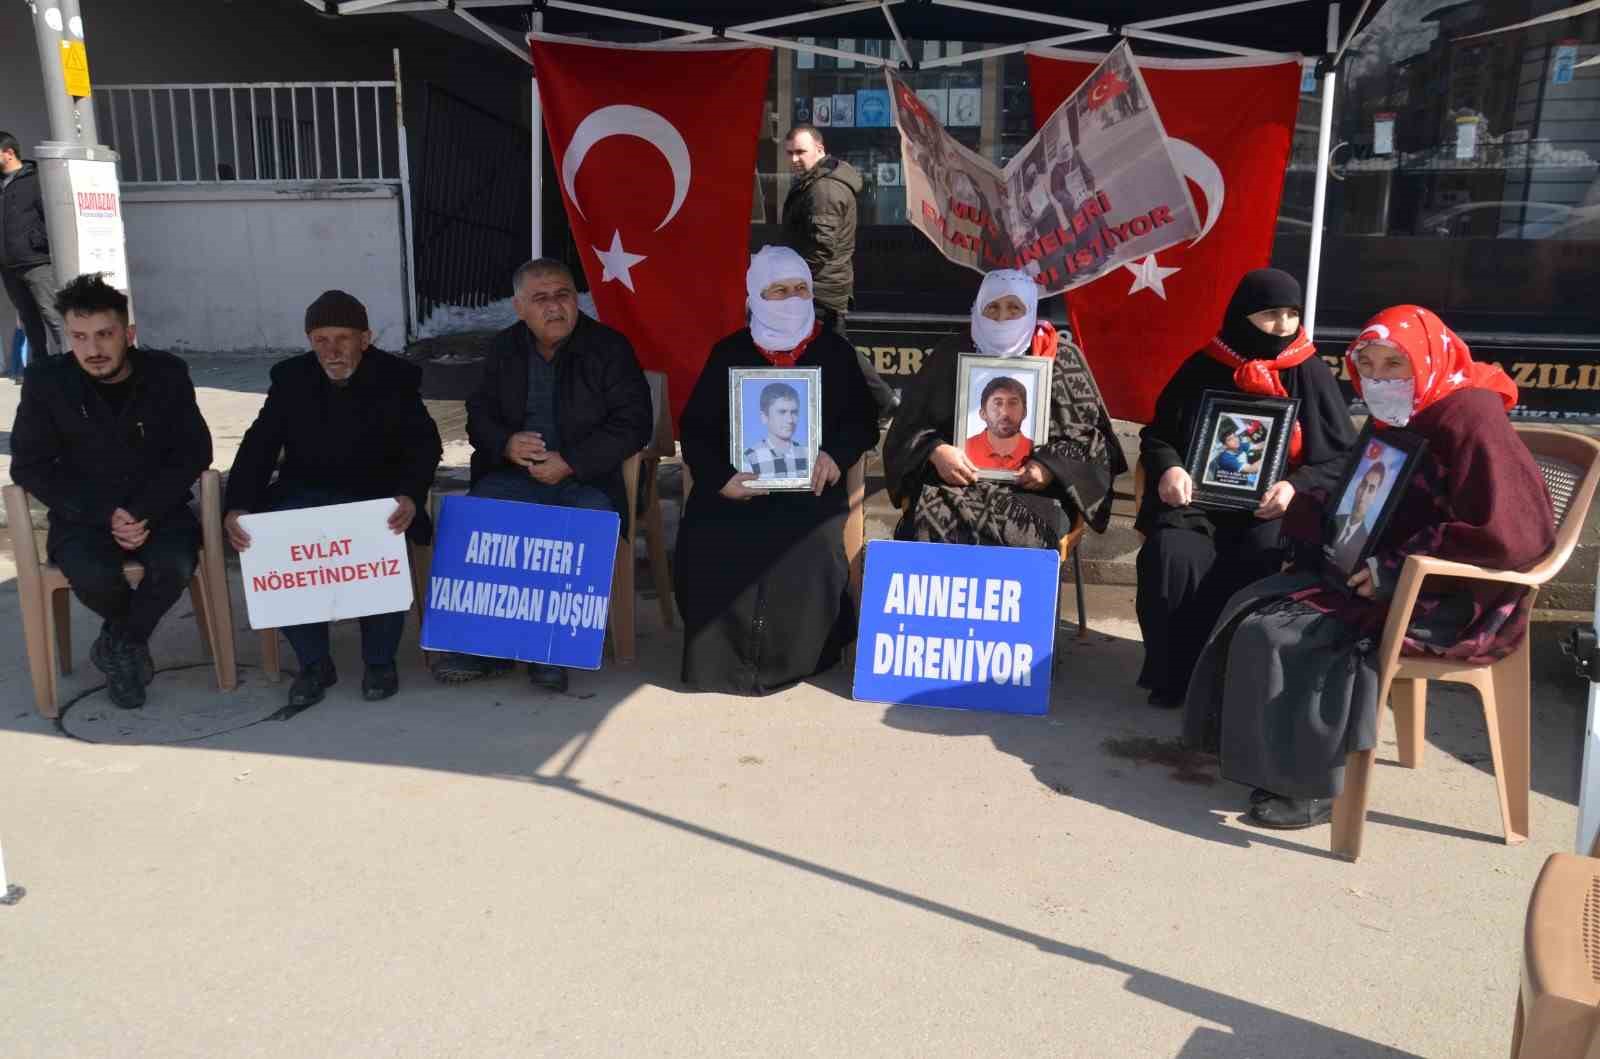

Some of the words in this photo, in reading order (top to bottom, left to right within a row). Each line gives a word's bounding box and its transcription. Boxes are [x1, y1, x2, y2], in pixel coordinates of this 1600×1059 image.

[290, 538, 352, 562] EVLAT
[464, 531, 520, 569] ARTIK
[522, 536, 575, 575] YETER
[252, 557, 401, 593] NÖBETİNDEYİZ
[882, 572, 1023, 623] ANNELER
[429, 576, 545, 623] YAKAMIZDAN
[546, 583, 609, 637] DÜŞÜN
[872, 622, 1033, 687] DİRENİYOR
